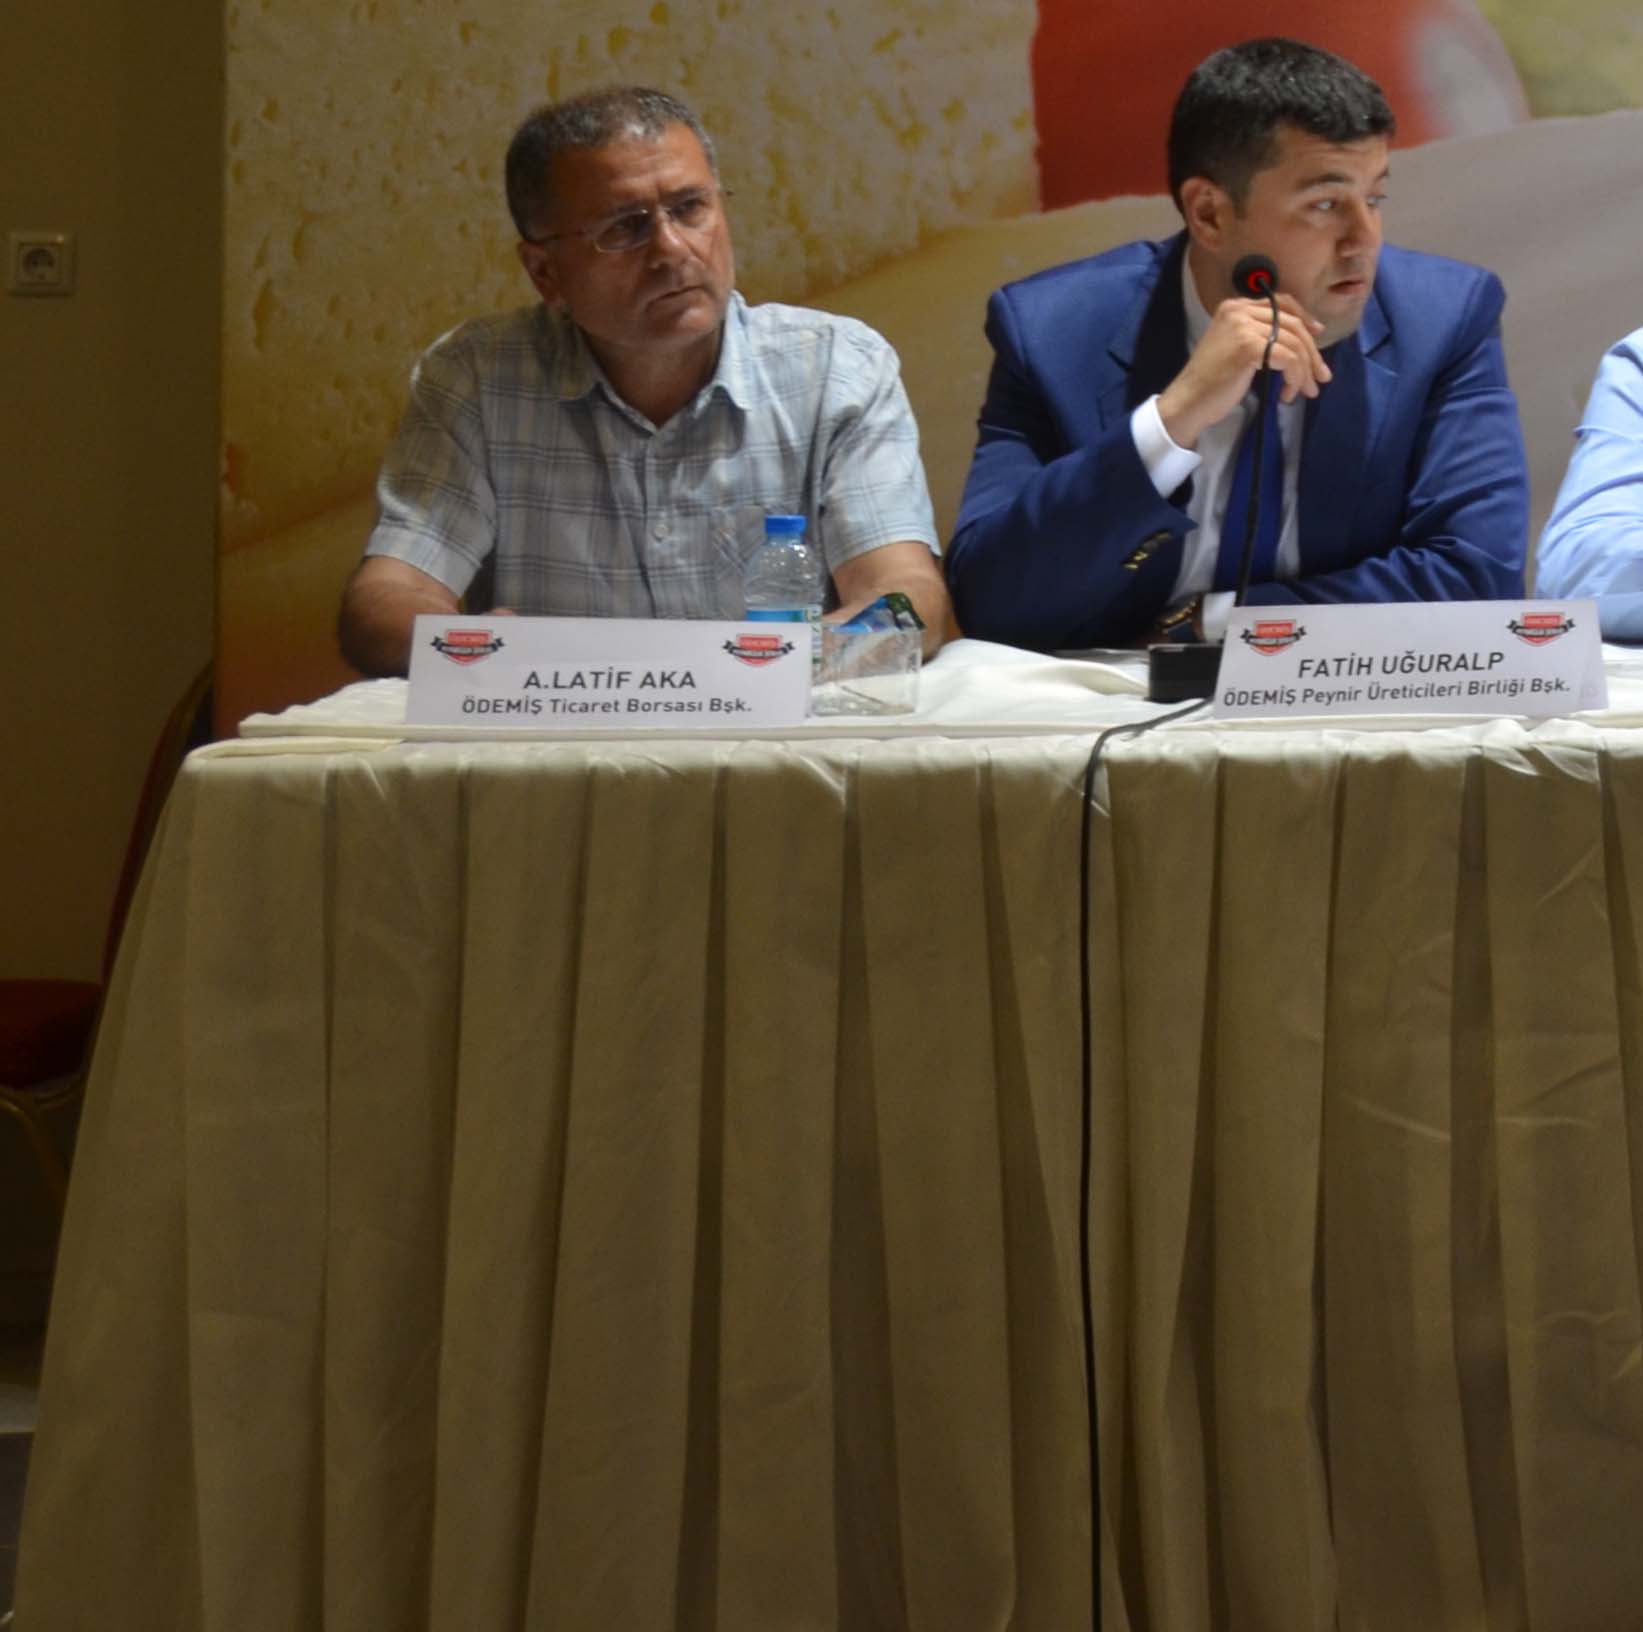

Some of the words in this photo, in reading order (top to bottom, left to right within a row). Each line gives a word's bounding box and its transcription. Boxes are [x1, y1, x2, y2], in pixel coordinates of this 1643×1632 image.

[523, 665, 632, 691] A.LATİF
[639, 670, 697, 690] AKA
[1297, 651, 1373, 679] FATİH
[1381, 649, 1505, 675] UĞURALP
[461, 695, 543, 717] ÖDEMİŞ
[550, 697, 619, 714] Ticaret
[626, 697, 703, 714] Borsası
[708, 697, 752, 716] Bşk.
[1223, 686, 1297, 708] ÖDEMİŞ
[1301, 685, 1362, 707] Peynir
[1367, 680, 1463, 701] Üreticileri
[1467, 678, 1525, 699] Birliği
[1531, 676, 1572, 696] Bşk.
